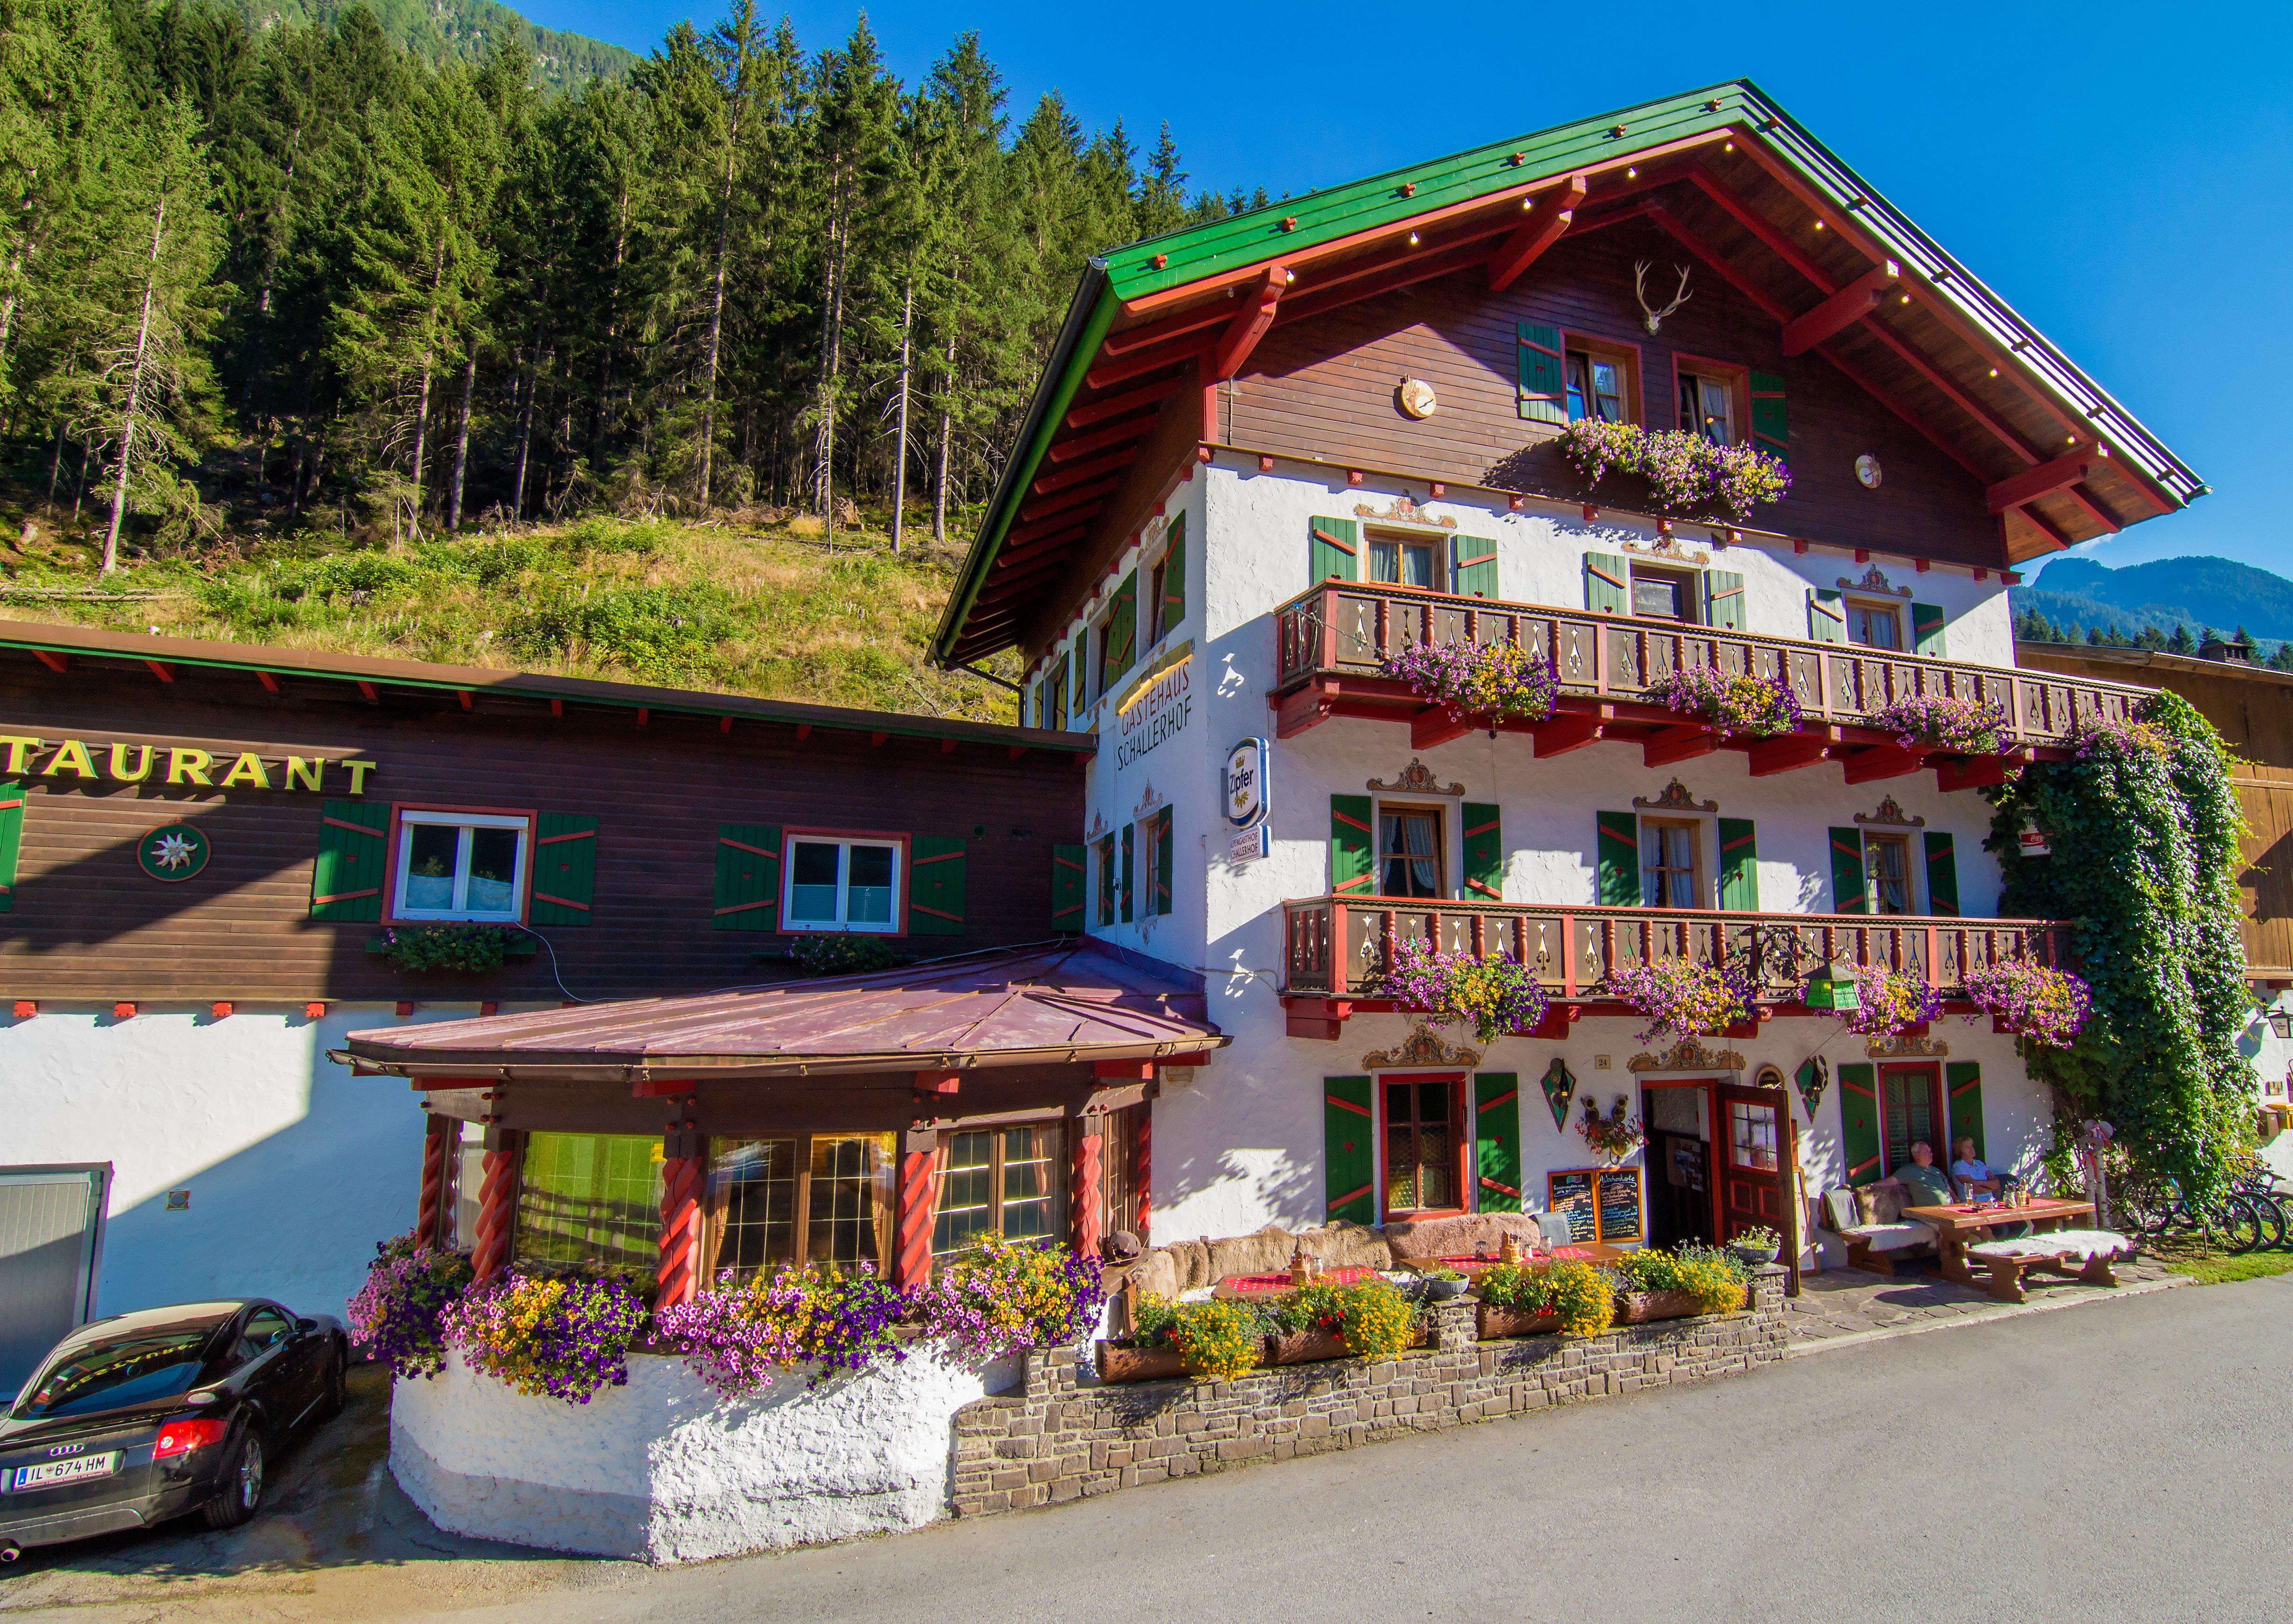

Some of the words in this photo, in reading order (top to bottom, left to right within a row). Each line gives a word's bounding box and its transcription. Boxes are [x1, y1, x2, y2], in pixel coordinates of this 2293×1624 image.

[1122, 662, 1189, 736] GÄSTEHAUS
[1118, 694, 1192, 771] SCHALLERHOF
[0, 735, 376, 794] TAURANT
[1230, 768, 1254, 797] Zipfer
[31, 1467, 43, 1481] IL
[55, 1460, 82, 1476] 674
[86, 1456, 106, 1471] HM
